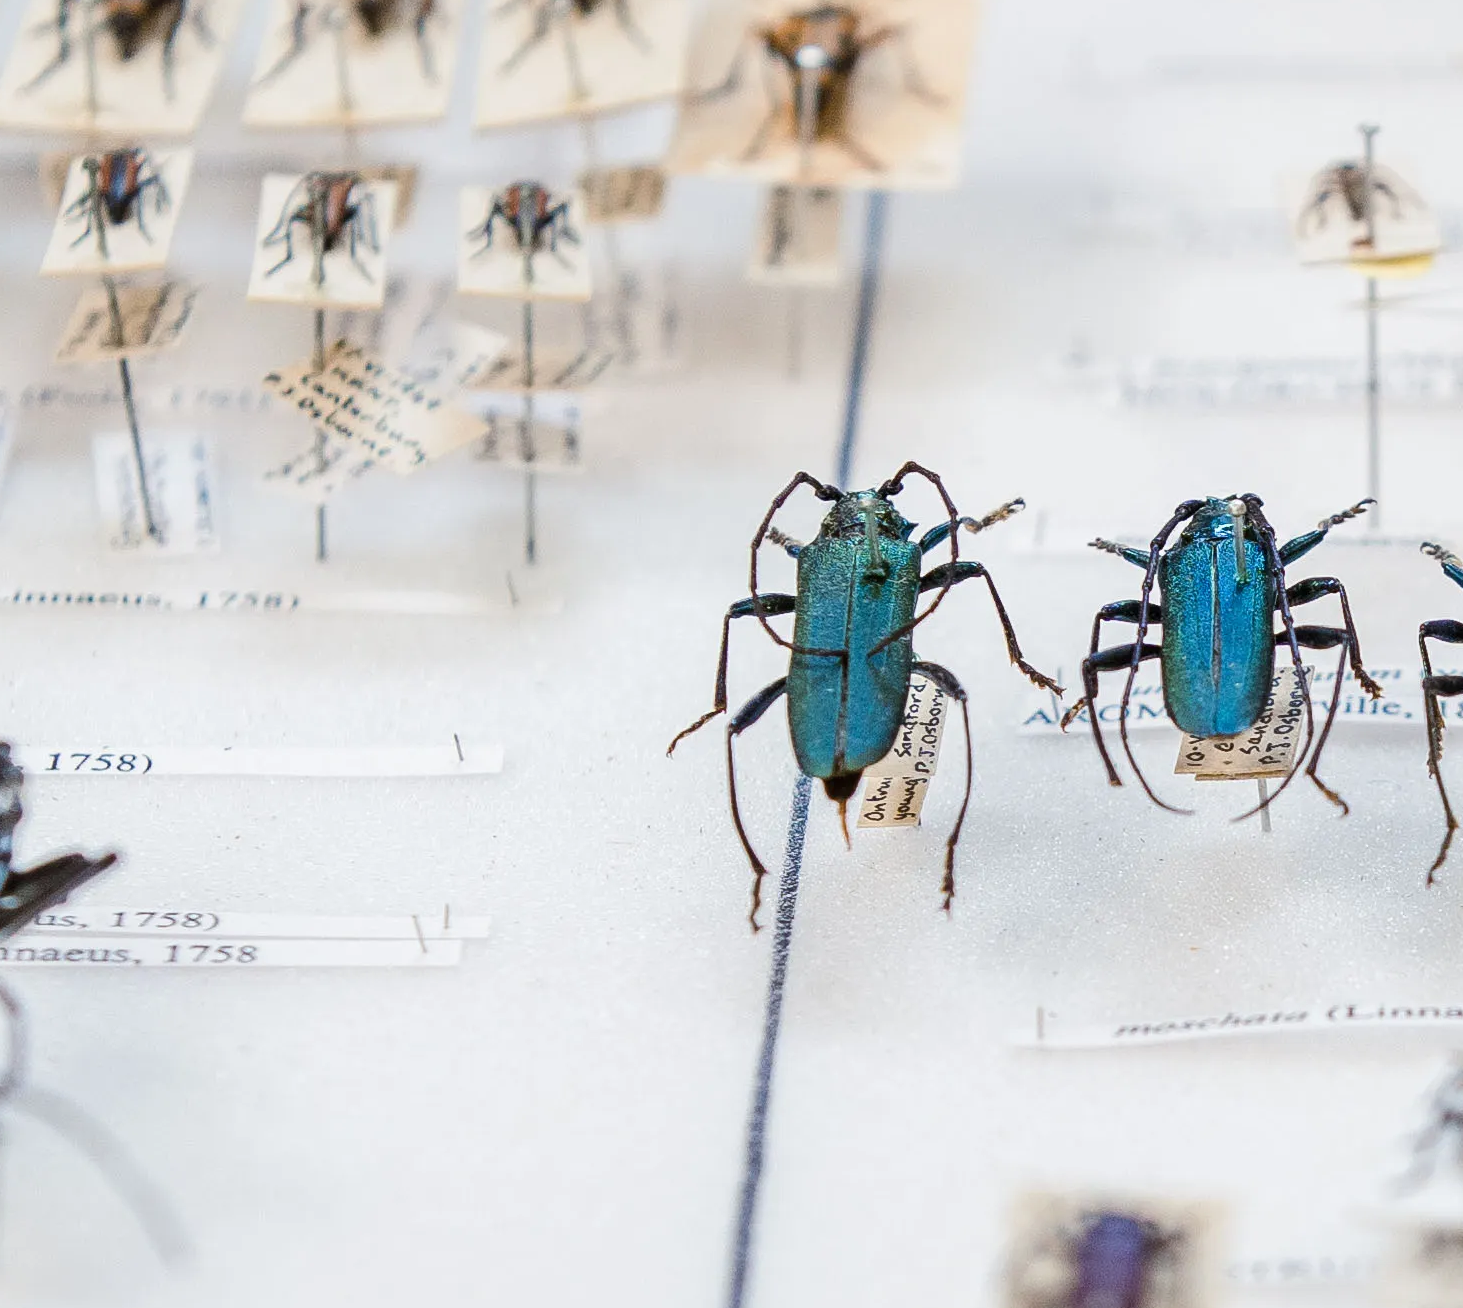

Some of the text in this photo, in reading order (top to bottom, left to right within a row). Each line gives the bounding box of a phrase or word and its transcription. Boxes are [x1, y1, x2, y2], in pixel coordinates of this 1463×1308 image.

[914, 687, 945, 774] P.J.Osborn
[44, 752, 154, 774] 1758)
[894, 778, 928, 821] young
[112, 910, 220, 932] 1758)
[162, 943, 259, 964] 1758
